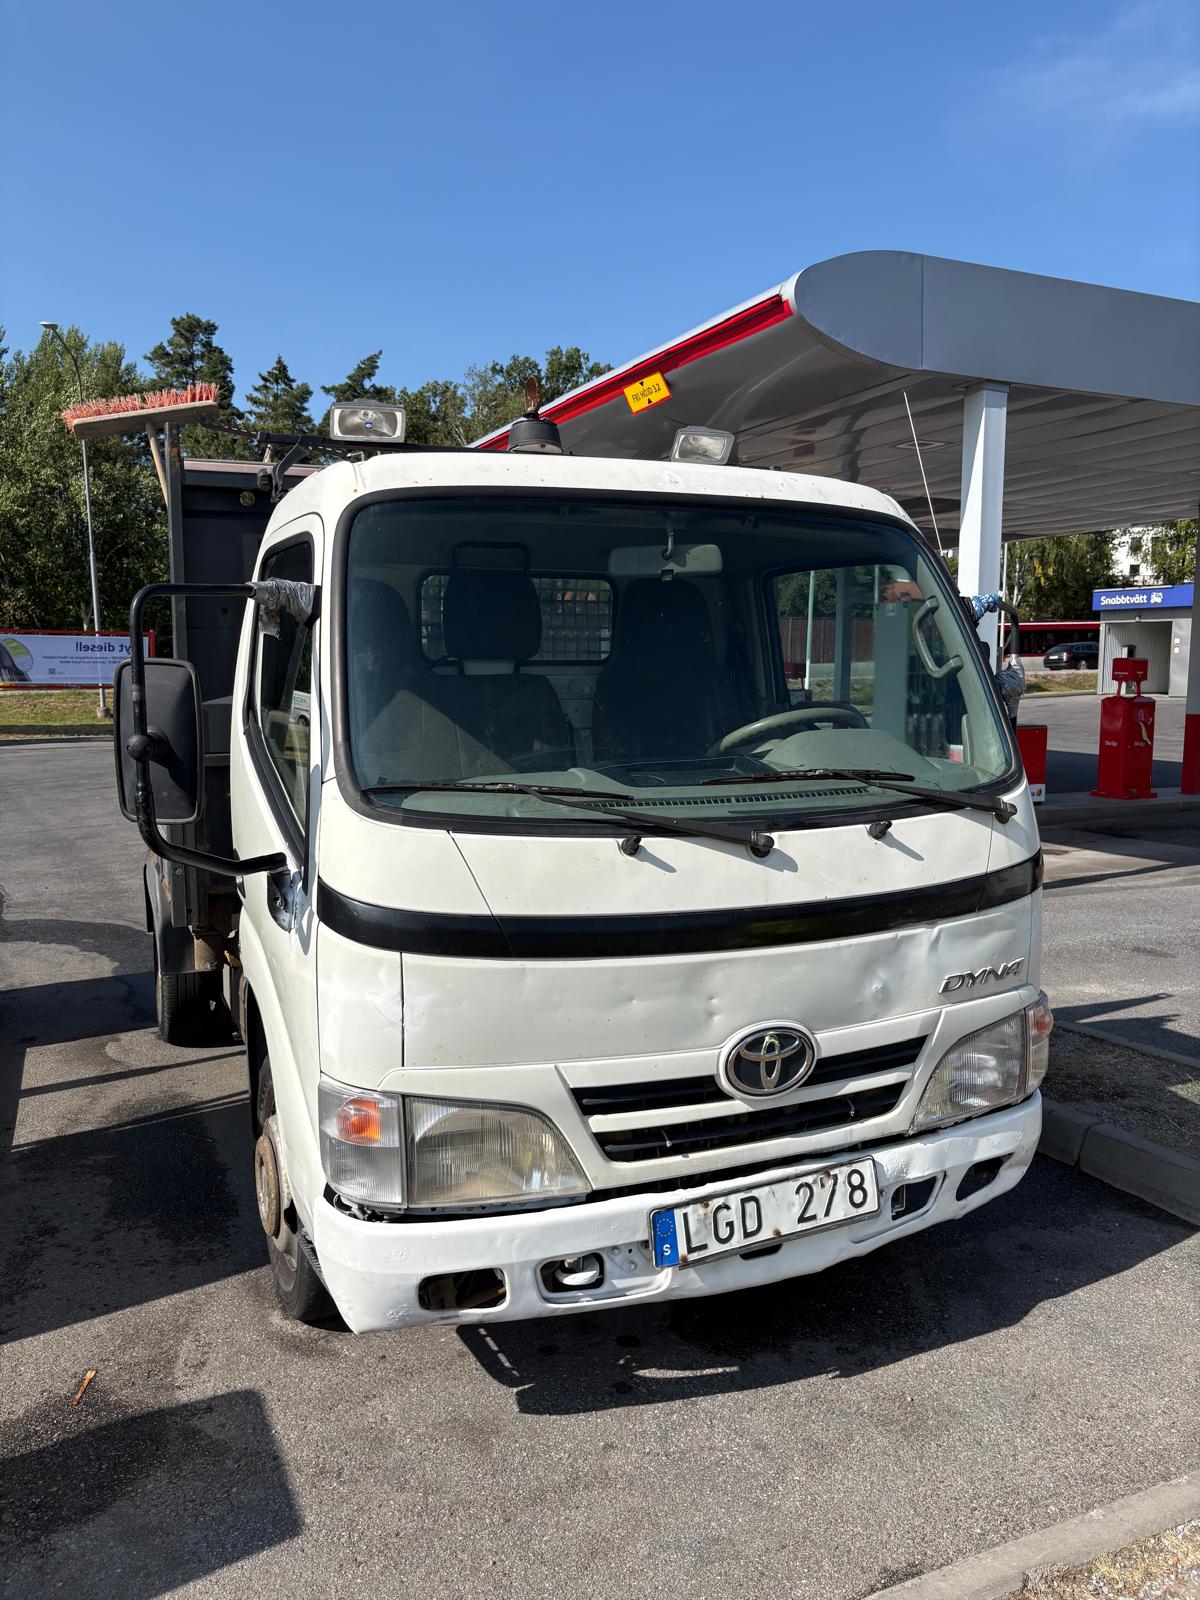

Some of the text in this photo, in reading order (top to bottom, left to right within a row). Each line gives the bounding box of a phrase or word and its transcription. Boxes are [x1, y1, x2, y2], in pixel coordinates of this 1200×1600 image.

[632, 392, 641, 403] FRI
[1101, 594, 1147, 605] Snabbtvätt
[938, 957, 1025, 994] DYNA
[682, 1168, 868, 1255] LGD 278
[662, 1243, 671, 1256] S
